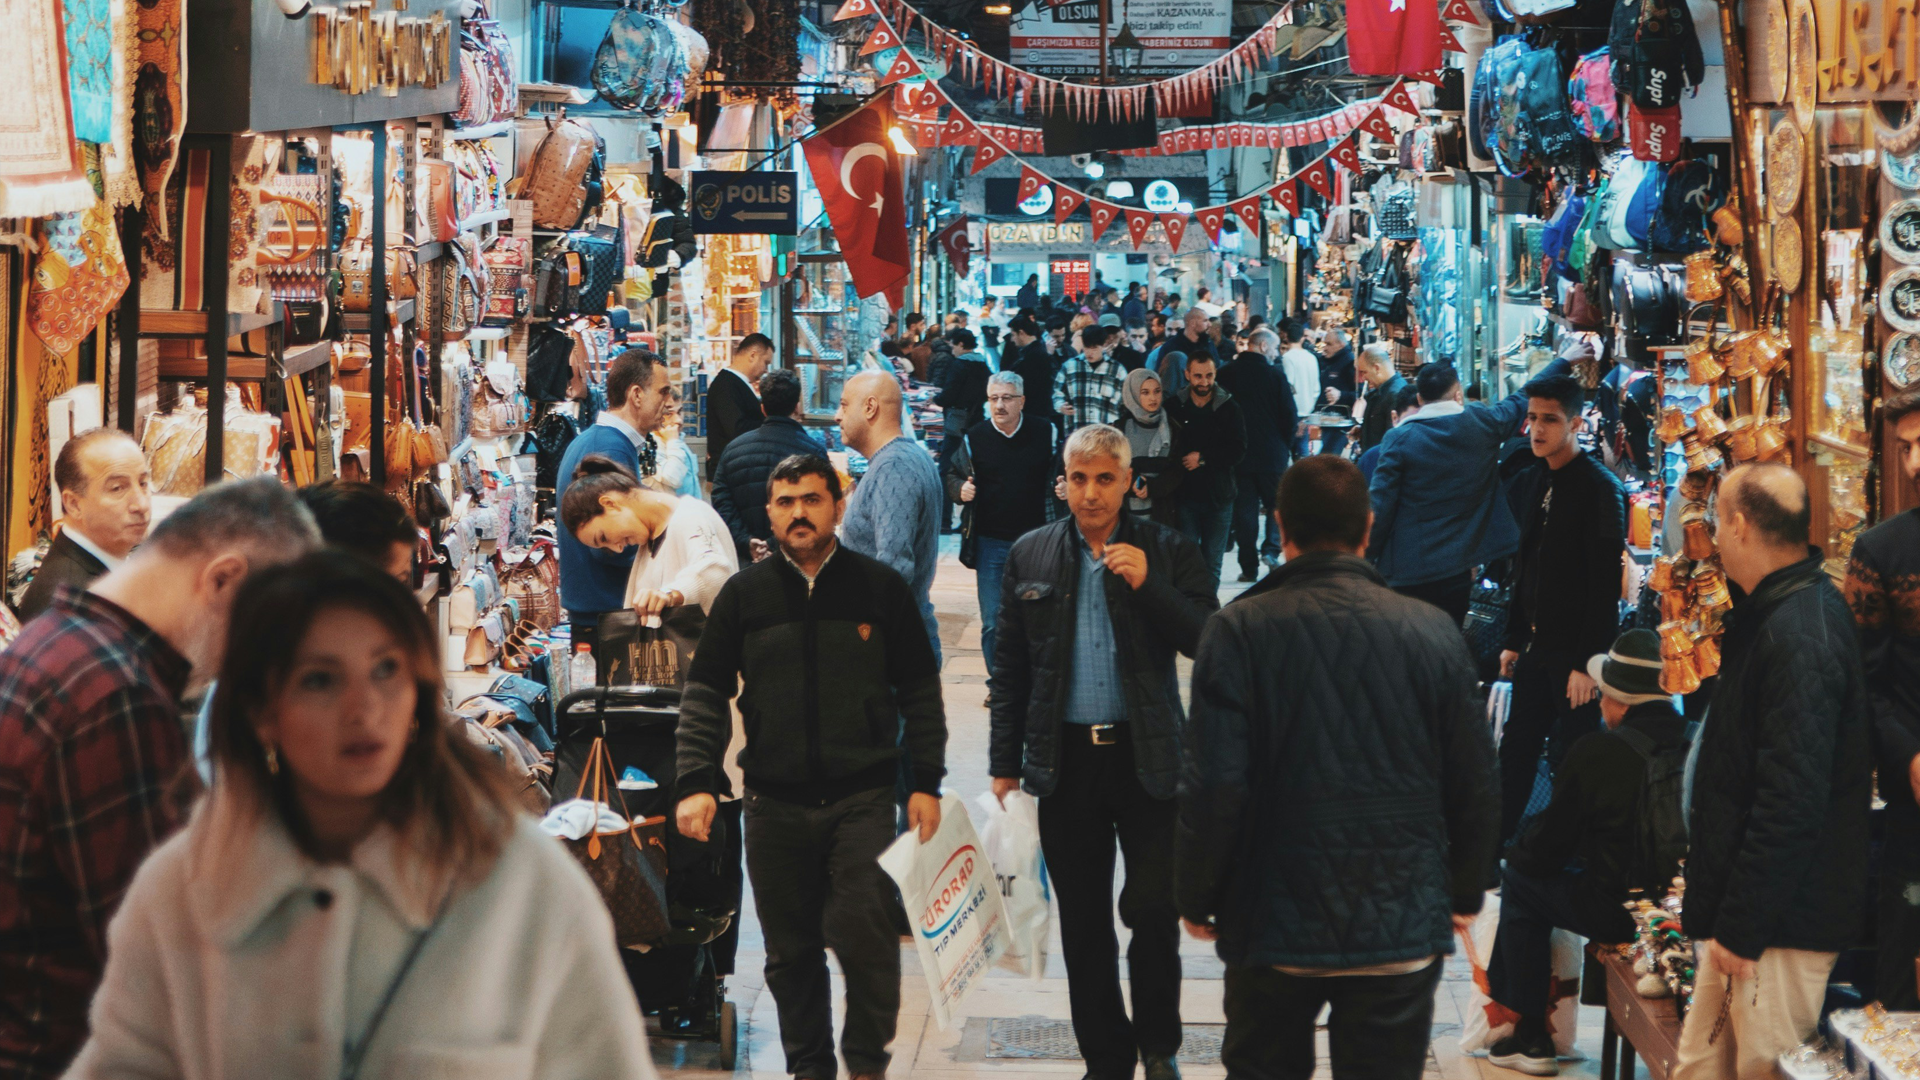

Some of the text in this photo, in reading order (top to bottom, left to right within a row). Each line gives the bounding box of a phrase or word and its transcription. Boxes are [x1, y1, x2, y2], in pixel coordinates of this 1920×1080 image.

[1058, 4, 1099, 20] OLSUN
[1157, 8, 1215, 17] KAZANMAK
[1130, 20, 1203, 31] bizi takip edin!
[1027, 38, 1073, 48] ÇARŞIMIZDA
[1075, 38, 1101, 47] NELER
[1183, 38, 1213, 47] OLSUN!
[1645, 67, 1667, 106] Supr
[1645, 122, 1666, 160] Supr
[726, 180, 792, 204] POLİS
[934, 935, 949, 958] TIP
[949, 883, 987, 938] MERKEZİ
